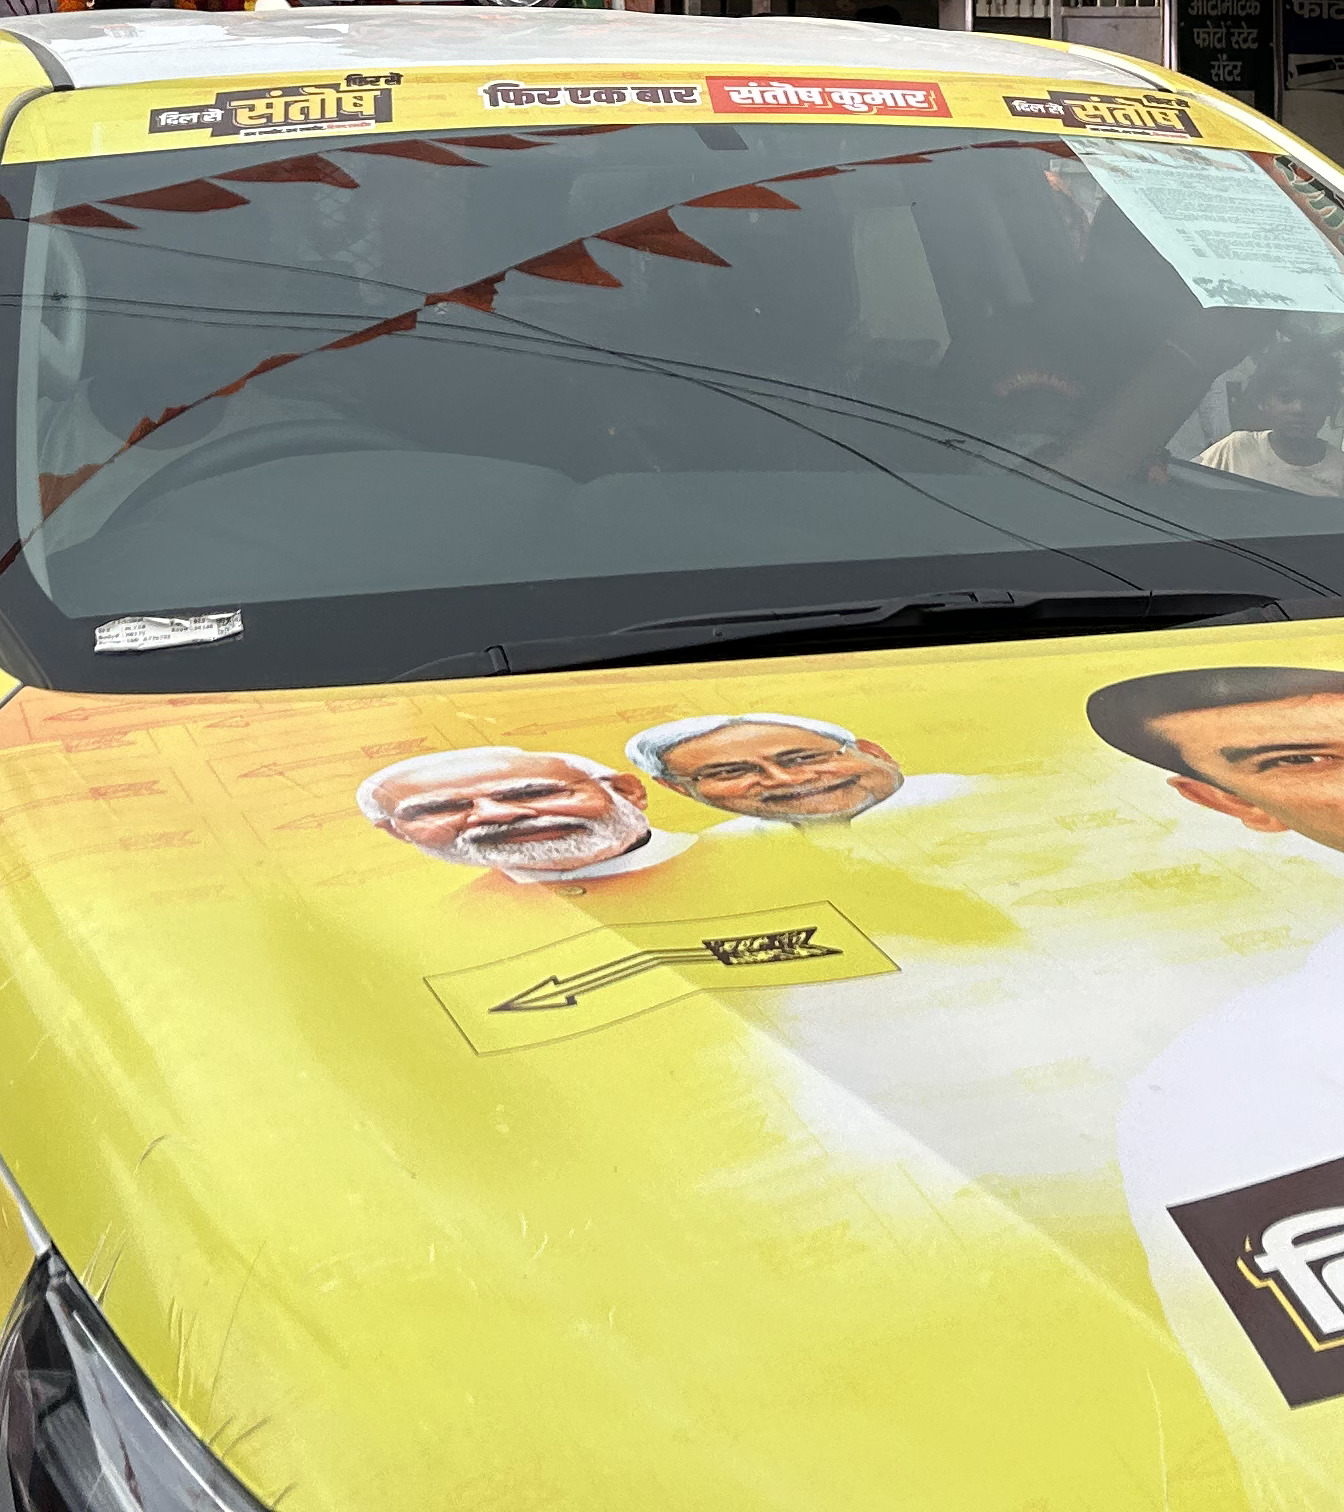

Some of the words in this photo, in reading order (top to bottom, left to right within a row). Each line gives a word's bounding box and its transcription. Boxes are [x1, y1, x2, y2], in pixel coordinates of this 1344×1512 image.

[1193, 20, 1226, 50] फोटो
[345, 73, 382, 88] फिर
[385, 72, 403, 86] से
[227, 87, 381, 128] संतोष
[484, 82, 562, 108] फिर
[565, 87, 628, 106] एक
[634, 86, 700, 107] बार
[724, 81, 825, 108] संतोष
[831, 87, 929, 114] कुमार
[1011, 100, 1045, 115] दिल
[158, 110, 199, 127] दिल
[202, 109, 225, 123] से
[1063, 96, 1186, 131] संतोष
